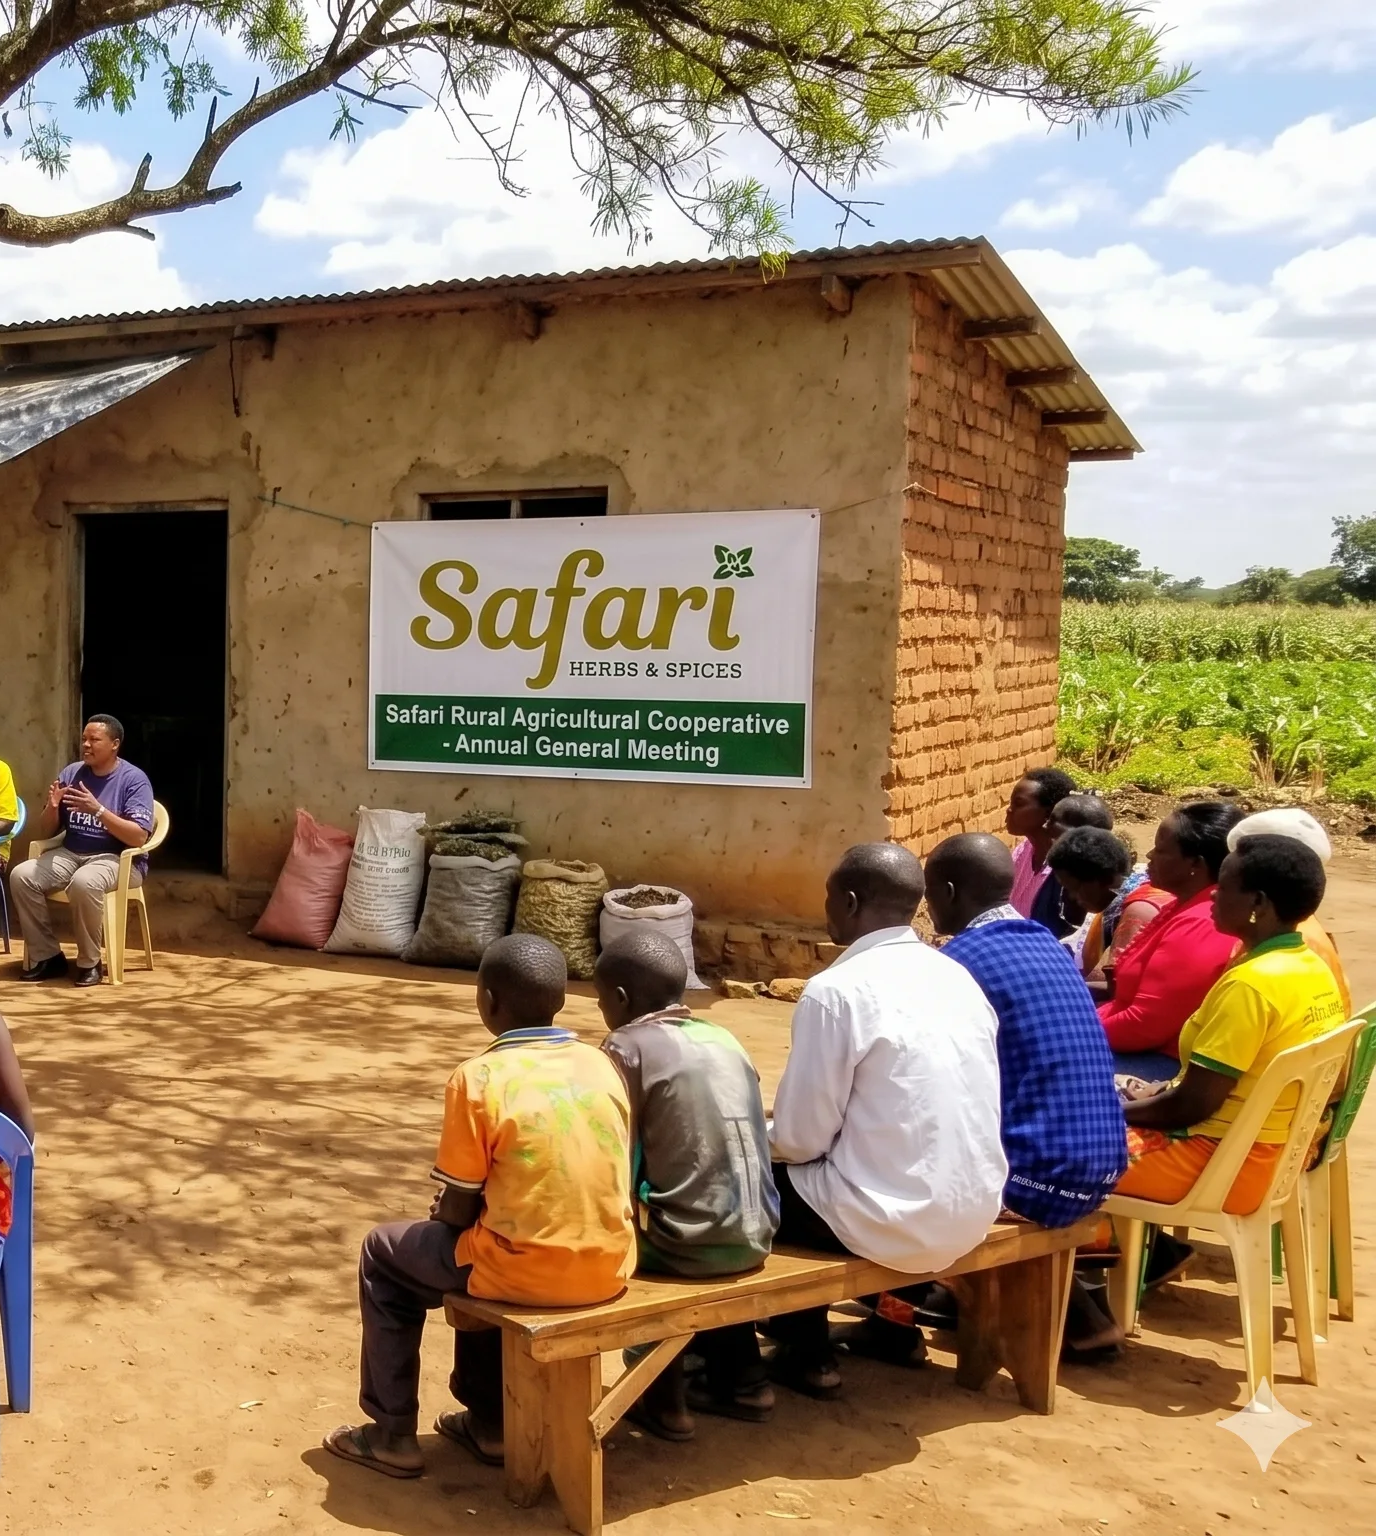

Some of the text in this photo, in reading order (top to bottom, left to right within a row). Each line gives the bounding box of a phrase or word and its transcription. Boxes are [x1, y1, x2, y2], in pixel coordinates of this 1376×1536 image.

[410, 548, 742, 690] Safari
[569, 661, 742, 679] HERBS & SPICES
[386, 703, 790, 735] Safari Rural Agricultural Cooperative
[454, 733, 528, 756] Annual
[535, 735, 620, 759] General
[627, 738, 719, 768] Meeting
